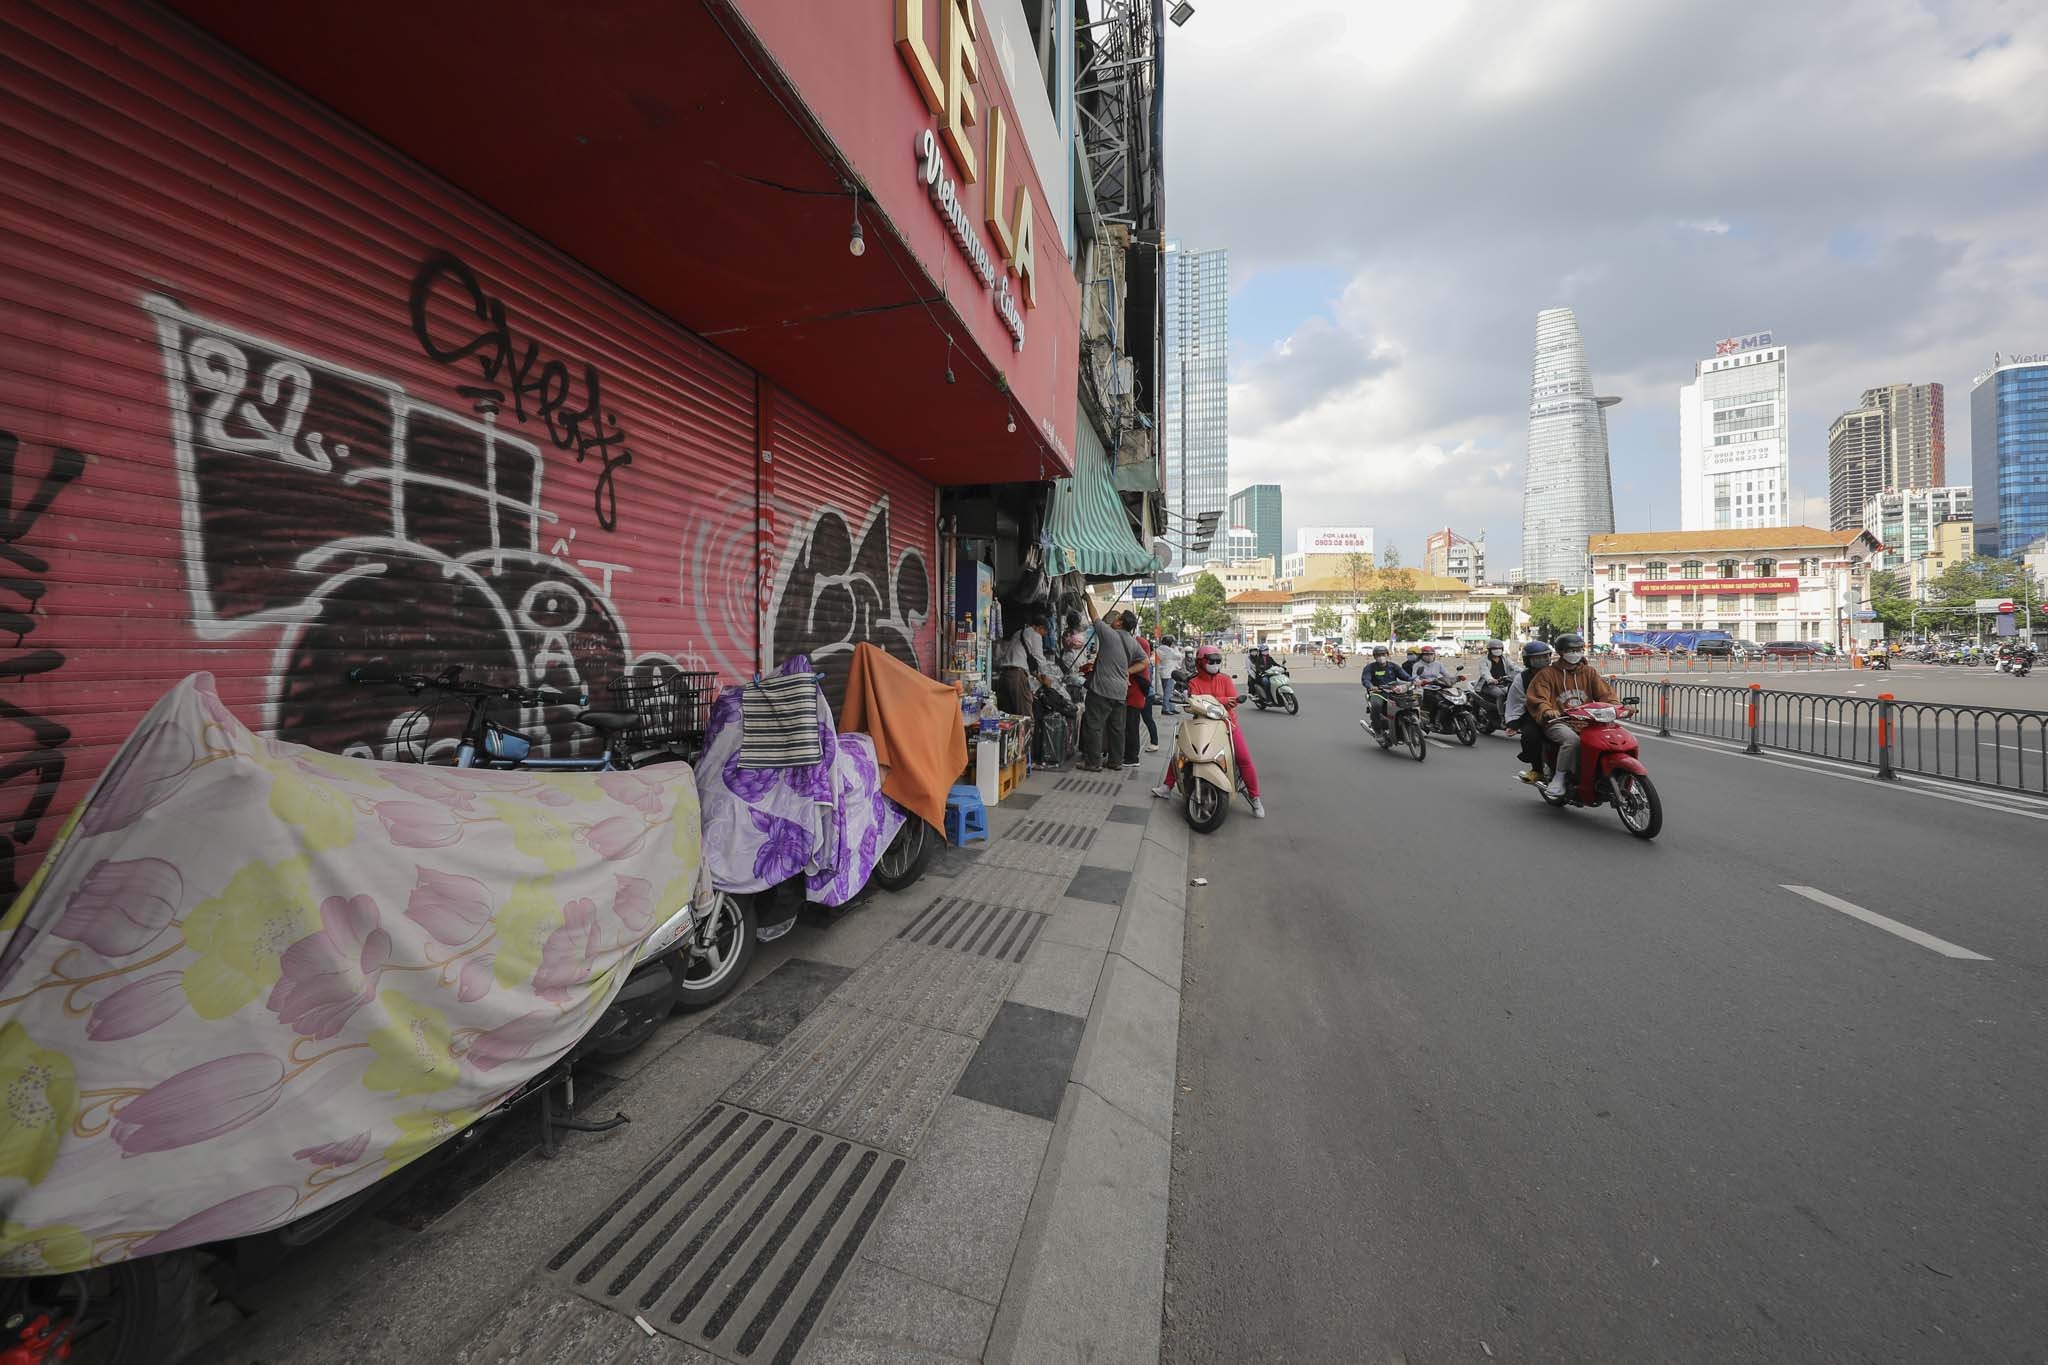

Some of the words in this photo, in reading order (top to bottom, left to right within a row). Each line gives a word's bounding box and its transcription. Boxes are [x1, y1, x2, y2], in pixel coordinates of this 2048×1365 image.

[919, 128, 995, 290] Vietnamese
[986, 105, 1036, 310] LA
[1741, 333, 1772, 349] MB
